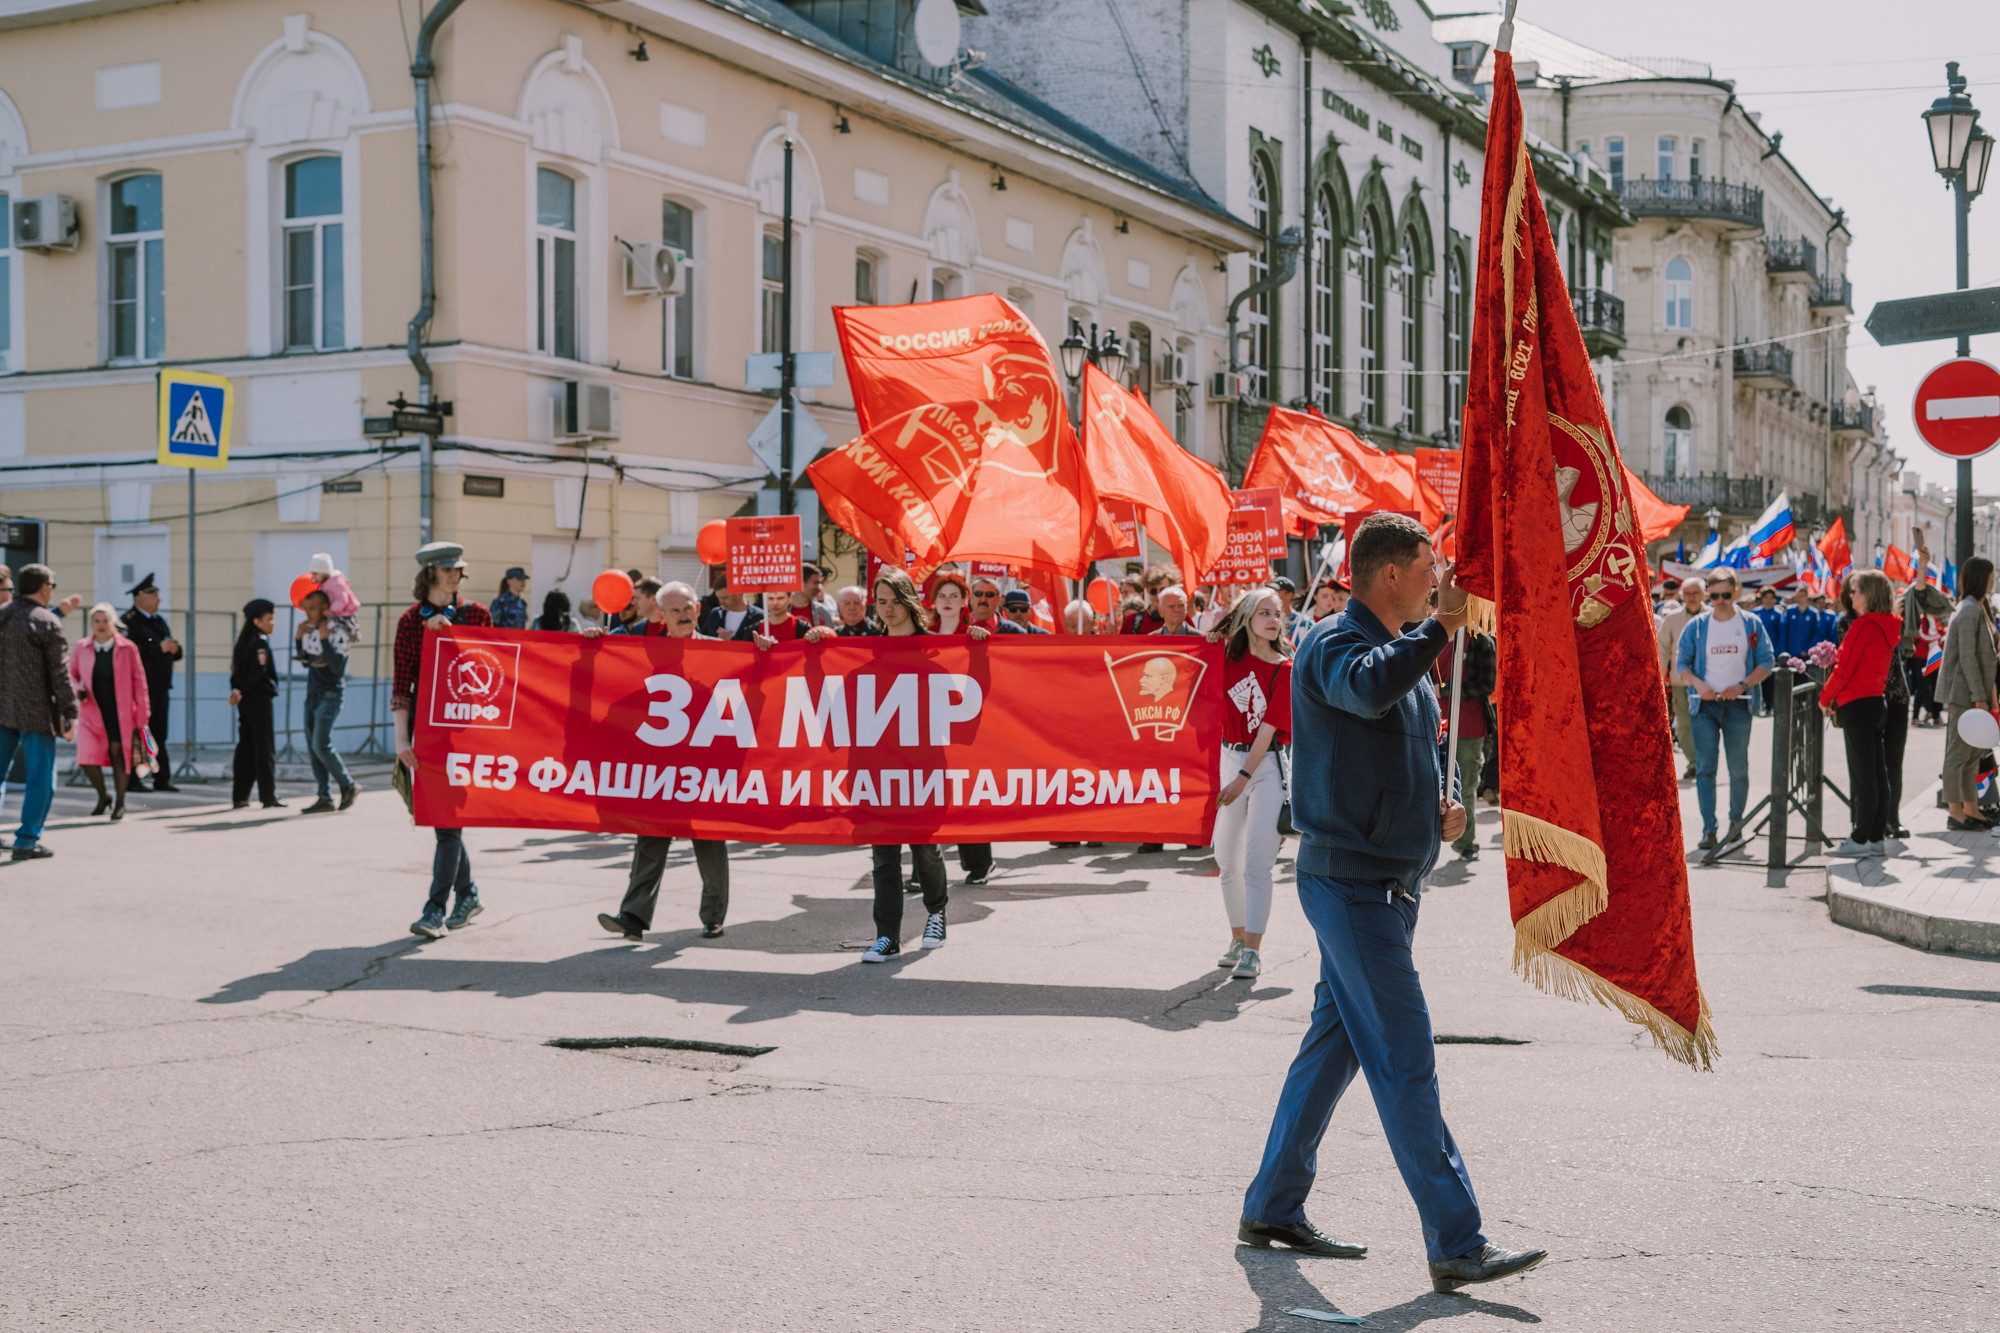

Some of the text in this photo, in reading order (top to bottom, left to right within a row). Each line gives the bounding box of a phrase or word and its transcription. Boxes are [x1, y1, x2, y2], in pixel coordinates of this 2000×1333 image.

[1510, 340, 1533, 381] всех
[929, 404, 979, 452] ЛКСМ
[837, 437, 900, 489] КИЙ
[1228, 530, 1263, 544] ОВОЙ
[731, 544, 796, 555] ОТ ВЛАСТИ
[1246, 544, 1263, 555] ЗА
[732, 565, 796, 575] К ДЕМОКРАТИИ
[732, 576, 739, 585] И
[444, 702, 500, 721] КПРФ
[636, 673, 983, 748] ЗА МИР
[1134, 706, 1181, 722] ЛКСМ РФ
[446, 752, 1181, 807] БЕЗ ФАШИЗМА И КАПИТАЛИЗМА!
